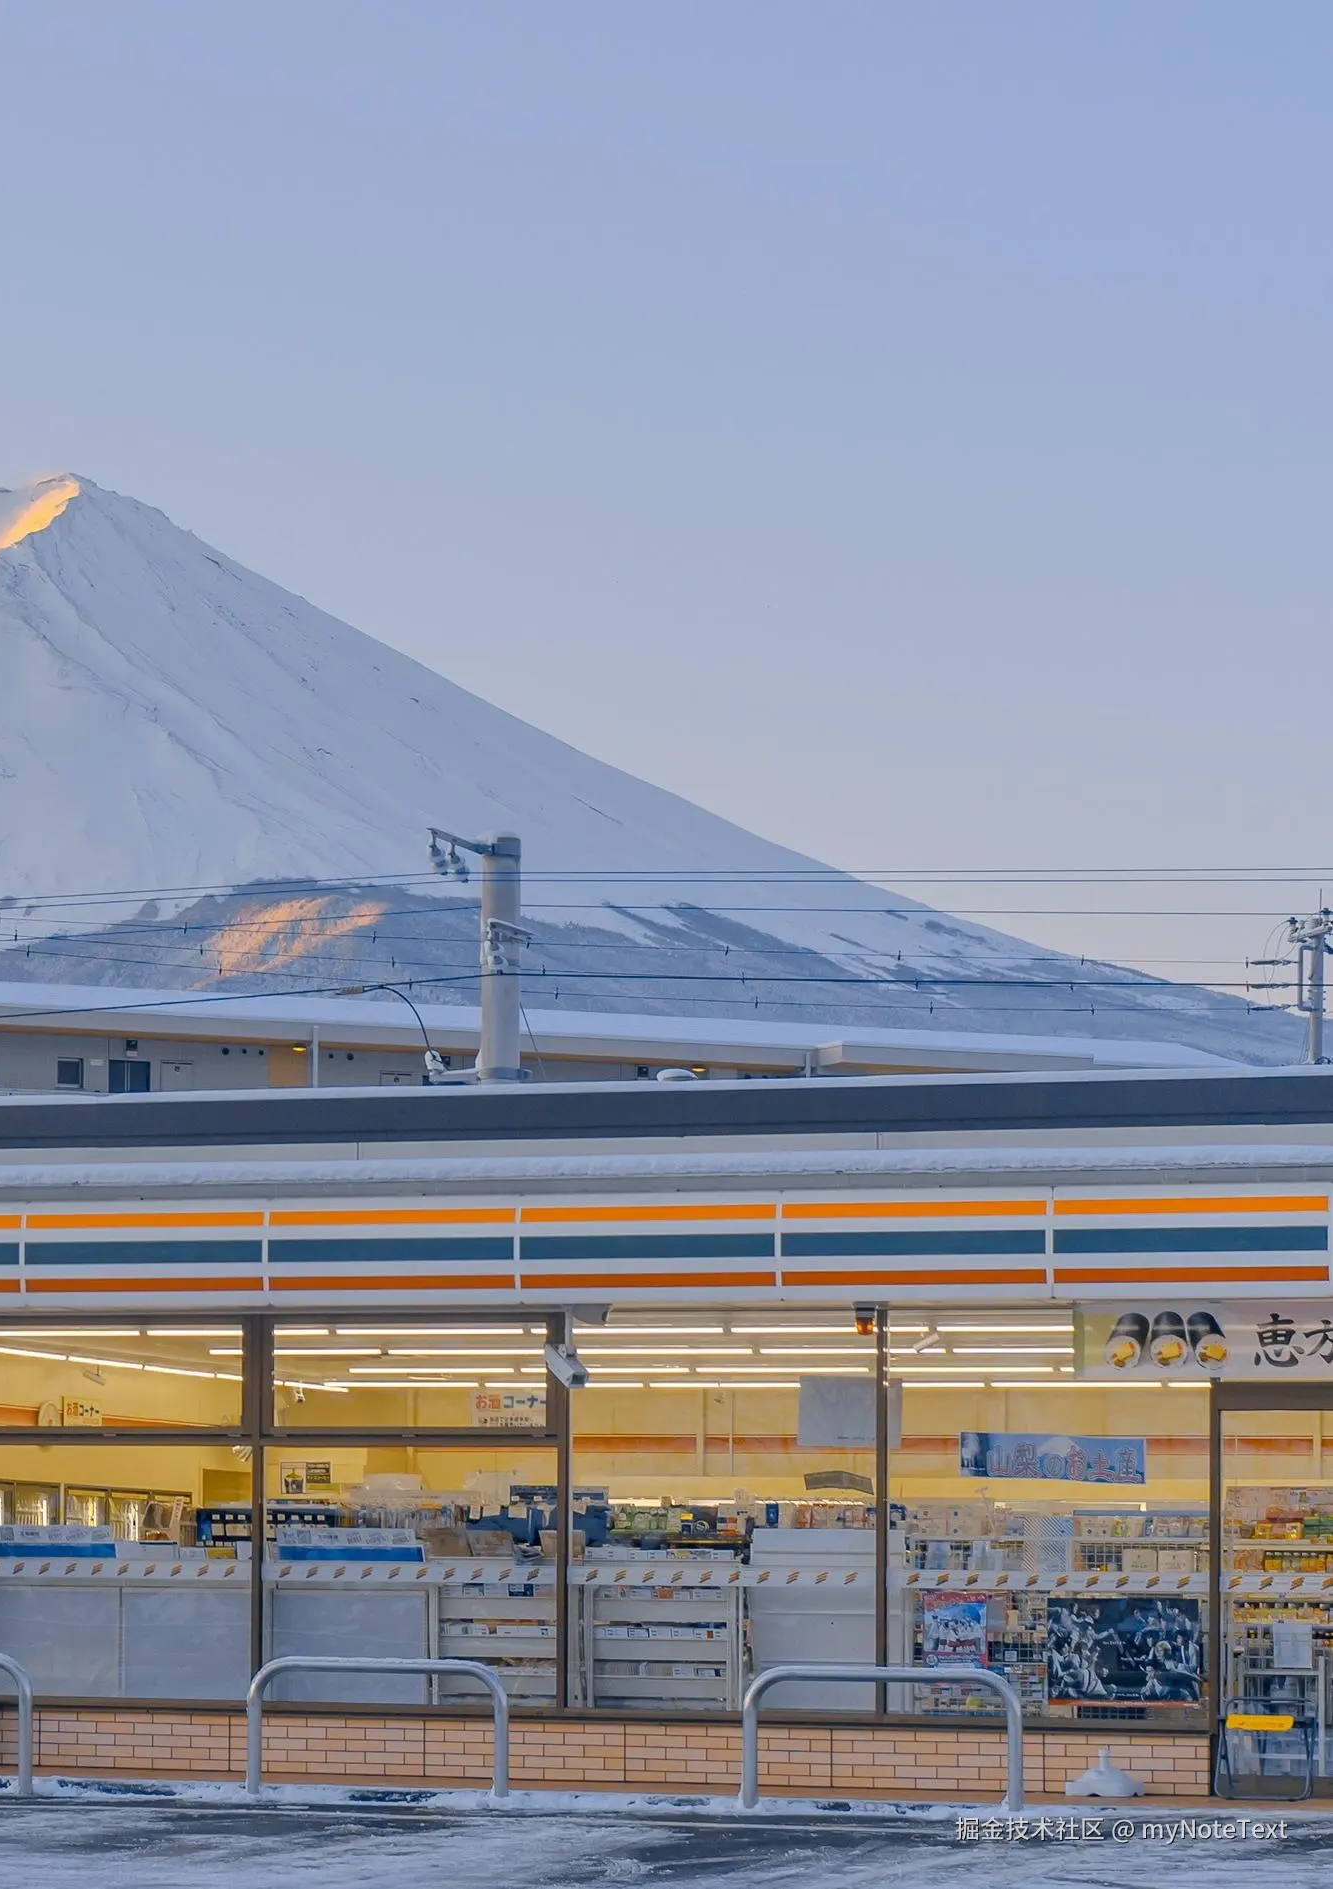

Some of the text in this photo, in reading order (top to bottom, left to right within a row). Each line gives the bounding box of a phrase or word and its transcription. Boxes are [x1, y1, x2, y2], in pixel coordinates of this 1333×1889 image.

[1253, 1312, 1333, 1368] 恵方
[986, 1440, 1143, 1484] 山梨のお土産
